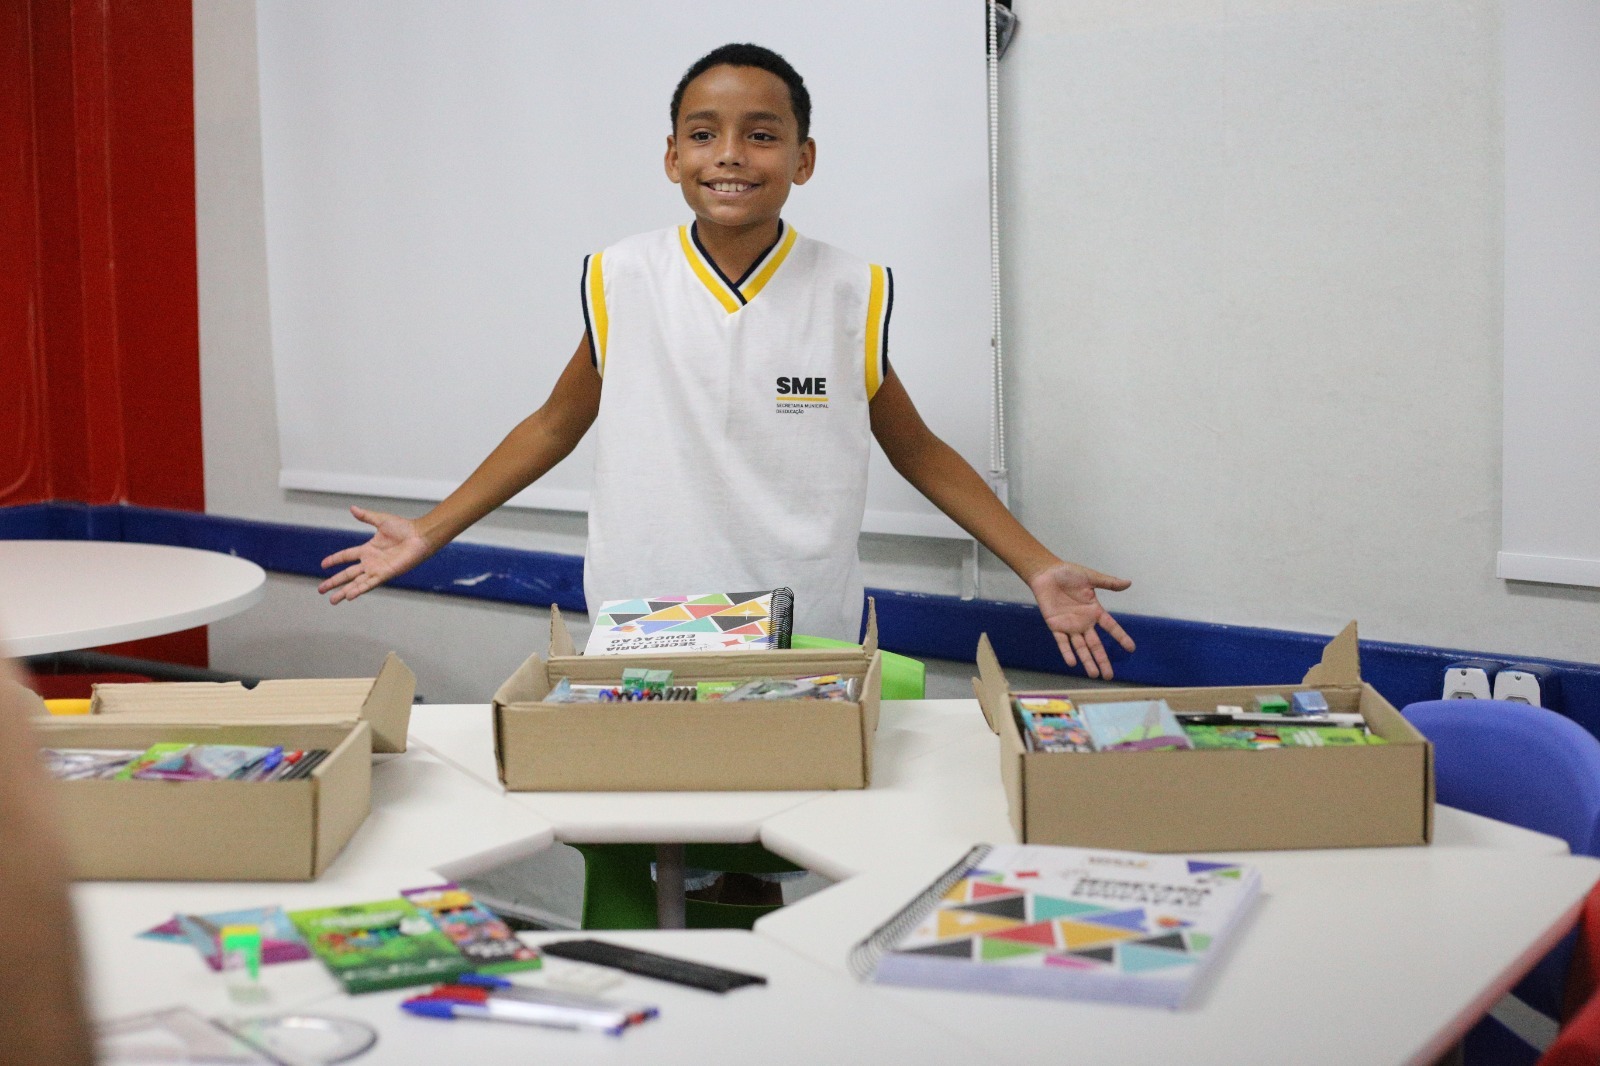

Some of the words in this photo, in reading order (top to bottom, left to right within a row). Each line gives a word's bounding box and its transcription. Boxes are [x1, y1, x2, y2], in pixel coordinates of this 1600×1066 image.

[776, 376, 827, 395] SME
[611, 634, 695, 643] EDUCAÇÃO
[606, 642, 696, 651] SECRETARIA
